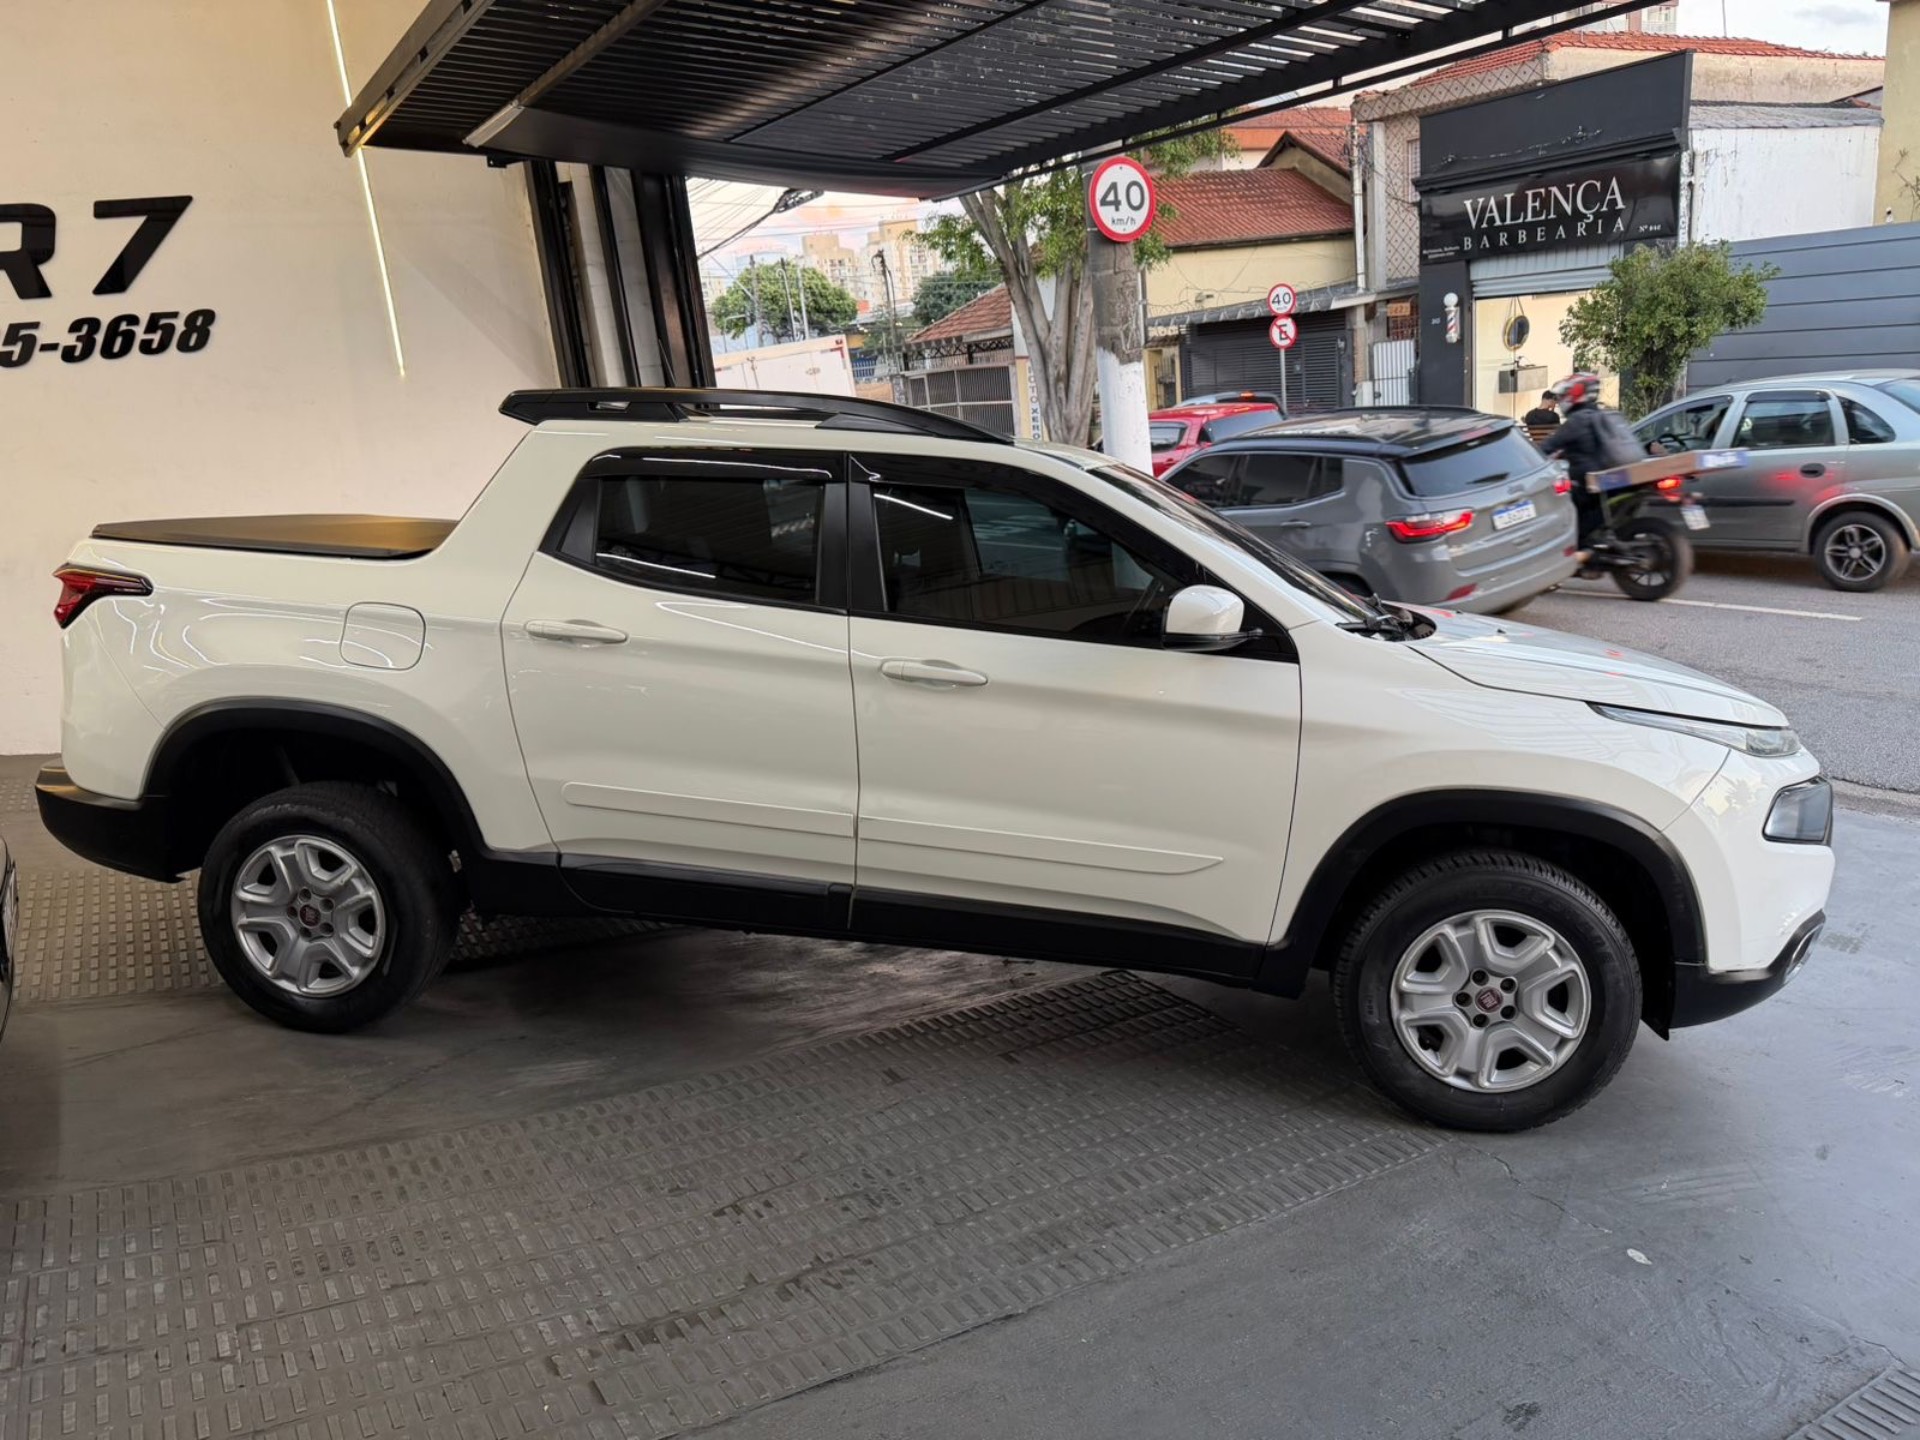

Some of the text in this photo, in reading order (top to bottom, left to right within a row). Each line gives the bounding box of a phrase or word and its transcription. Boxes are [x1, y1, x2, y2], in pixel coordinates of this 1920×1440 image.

[1099, 180, 1145, 212] 40
[1463, 176, 1626, 230] VALENÇA
[1111, 216, 1136, 226] km/h
[1463, 216, 1625, 250] BARBEARIA
[1271, 292, 1292, 305] 40
[0, 309, 216, 368] 5-3658
[1279, 323, 1289, 341] E
